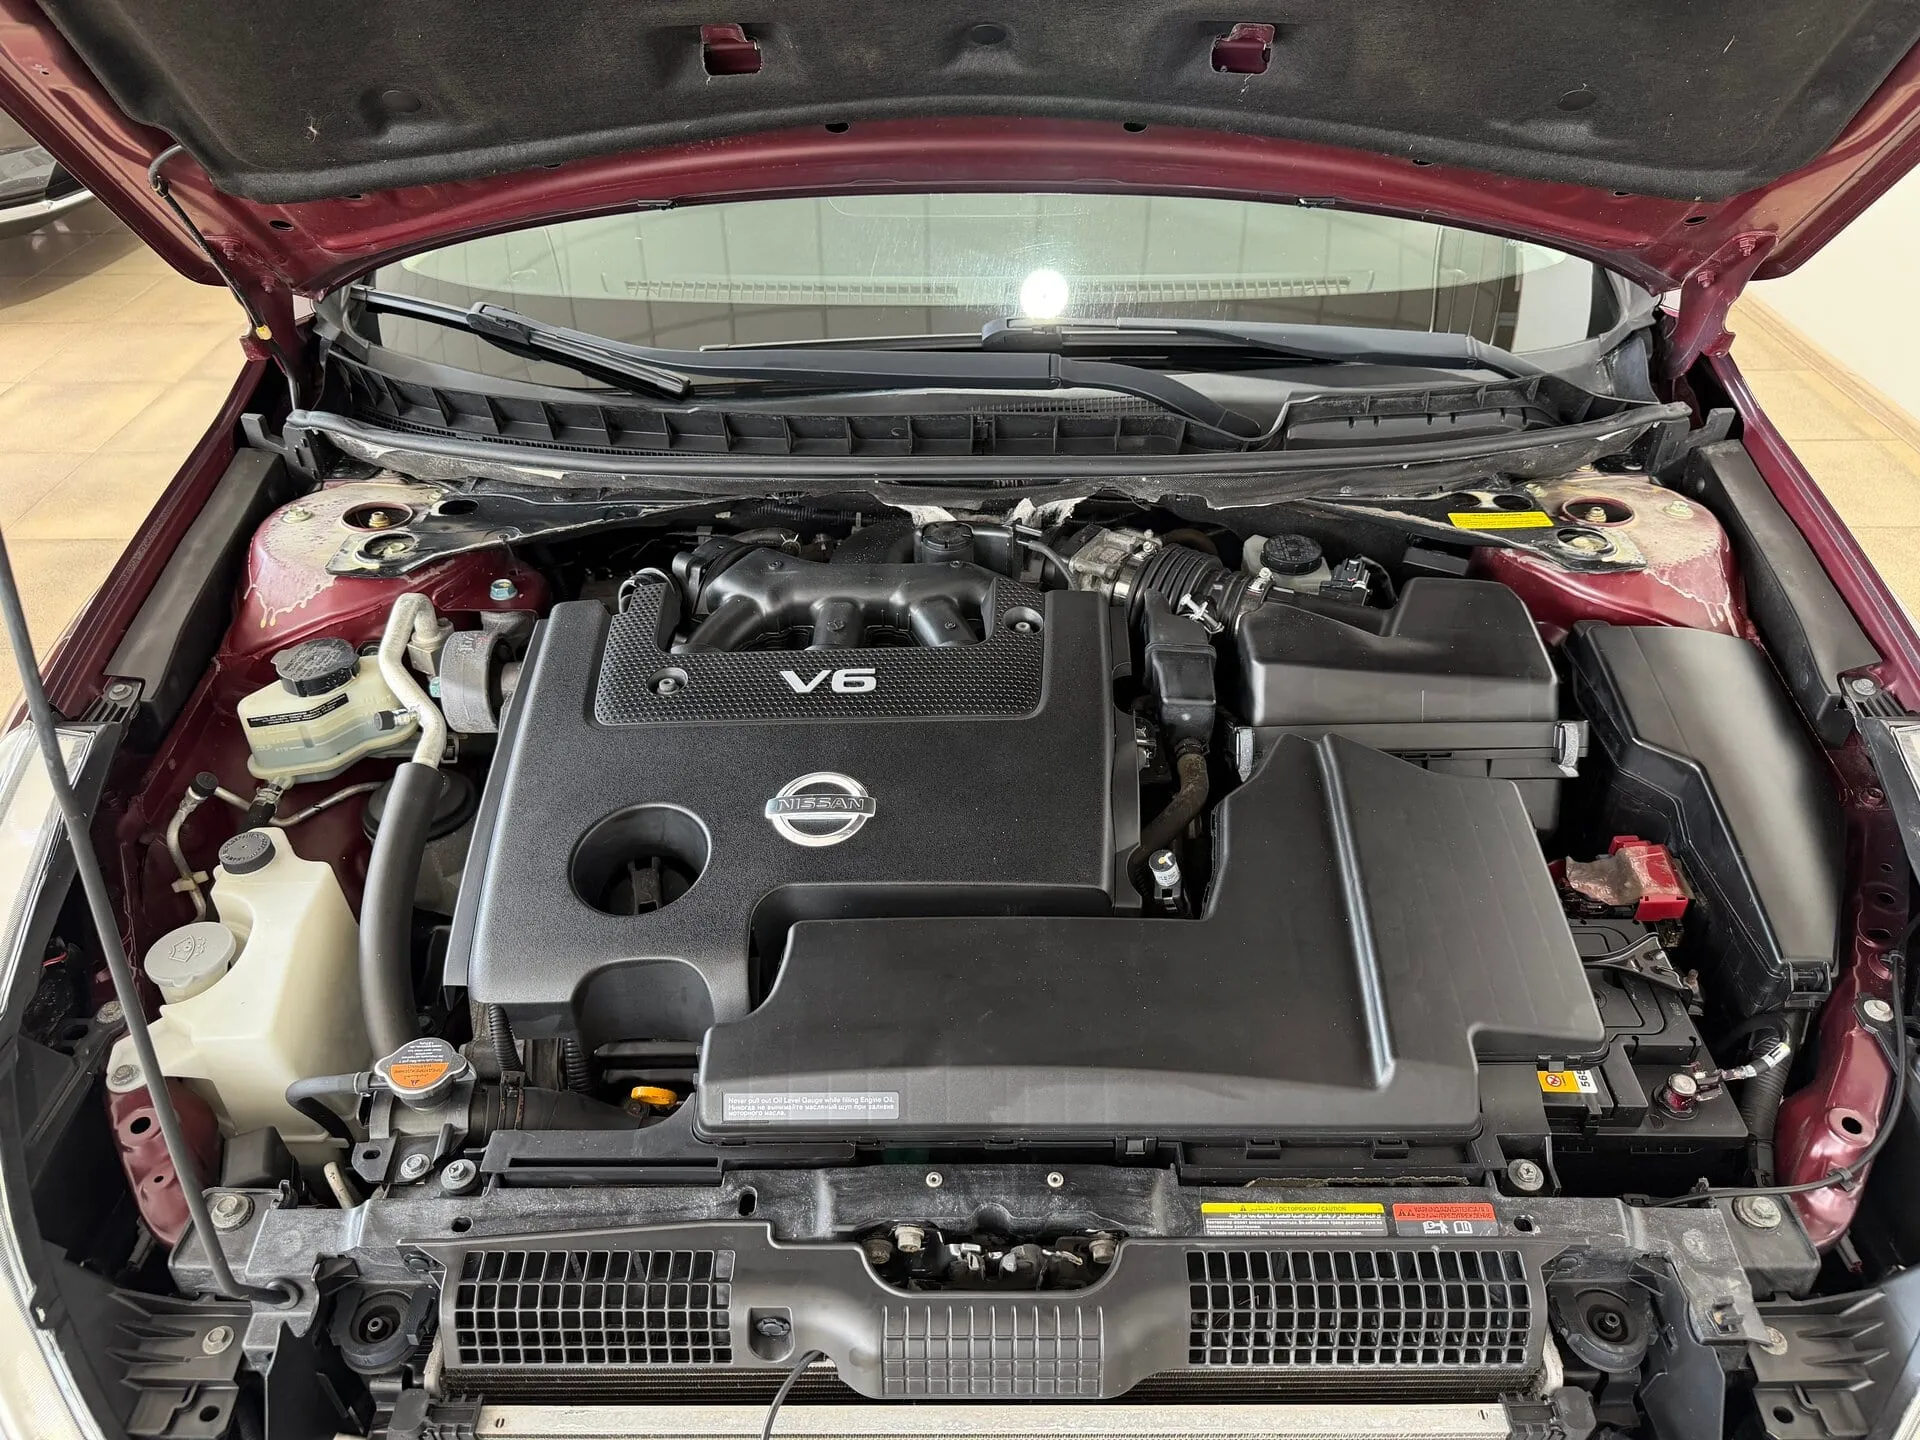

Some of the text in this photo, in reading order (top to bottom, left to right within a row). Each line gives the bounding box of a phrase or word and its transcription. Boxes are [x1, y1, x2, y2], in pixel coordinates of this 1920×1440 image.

[780, 668, 877, 693] V6
[775, 797, 865, 812] NISSAN
[772, 1096, 783, 1104] Oil
[784, 1096, 801, 1104] Level
[802, 1096, 824, 1105] Gauge
[824, 1096, 841, 1104] while
[860, 1096, 882, 1105] Engine
